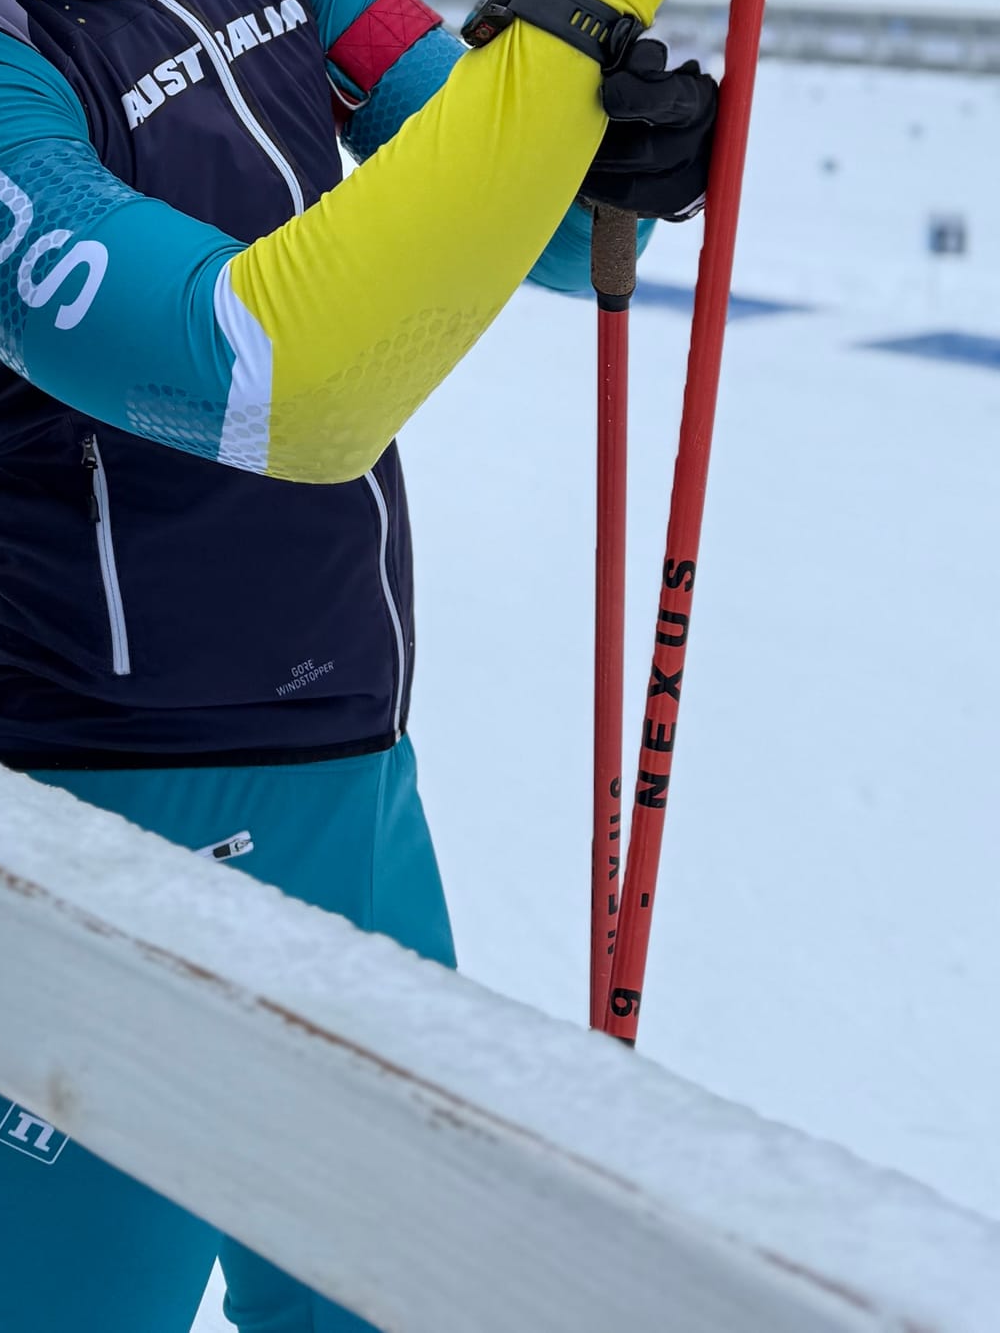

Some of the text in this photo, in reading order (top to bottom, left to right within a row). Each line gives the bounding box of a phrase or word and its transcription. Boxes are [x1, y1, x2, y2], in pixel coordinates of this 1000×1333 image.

[275, 661, 335, 697] WINDSTOPPER
[290, 659, 315, 678] GORE
[635, 558, 698, 810] NEXUS
